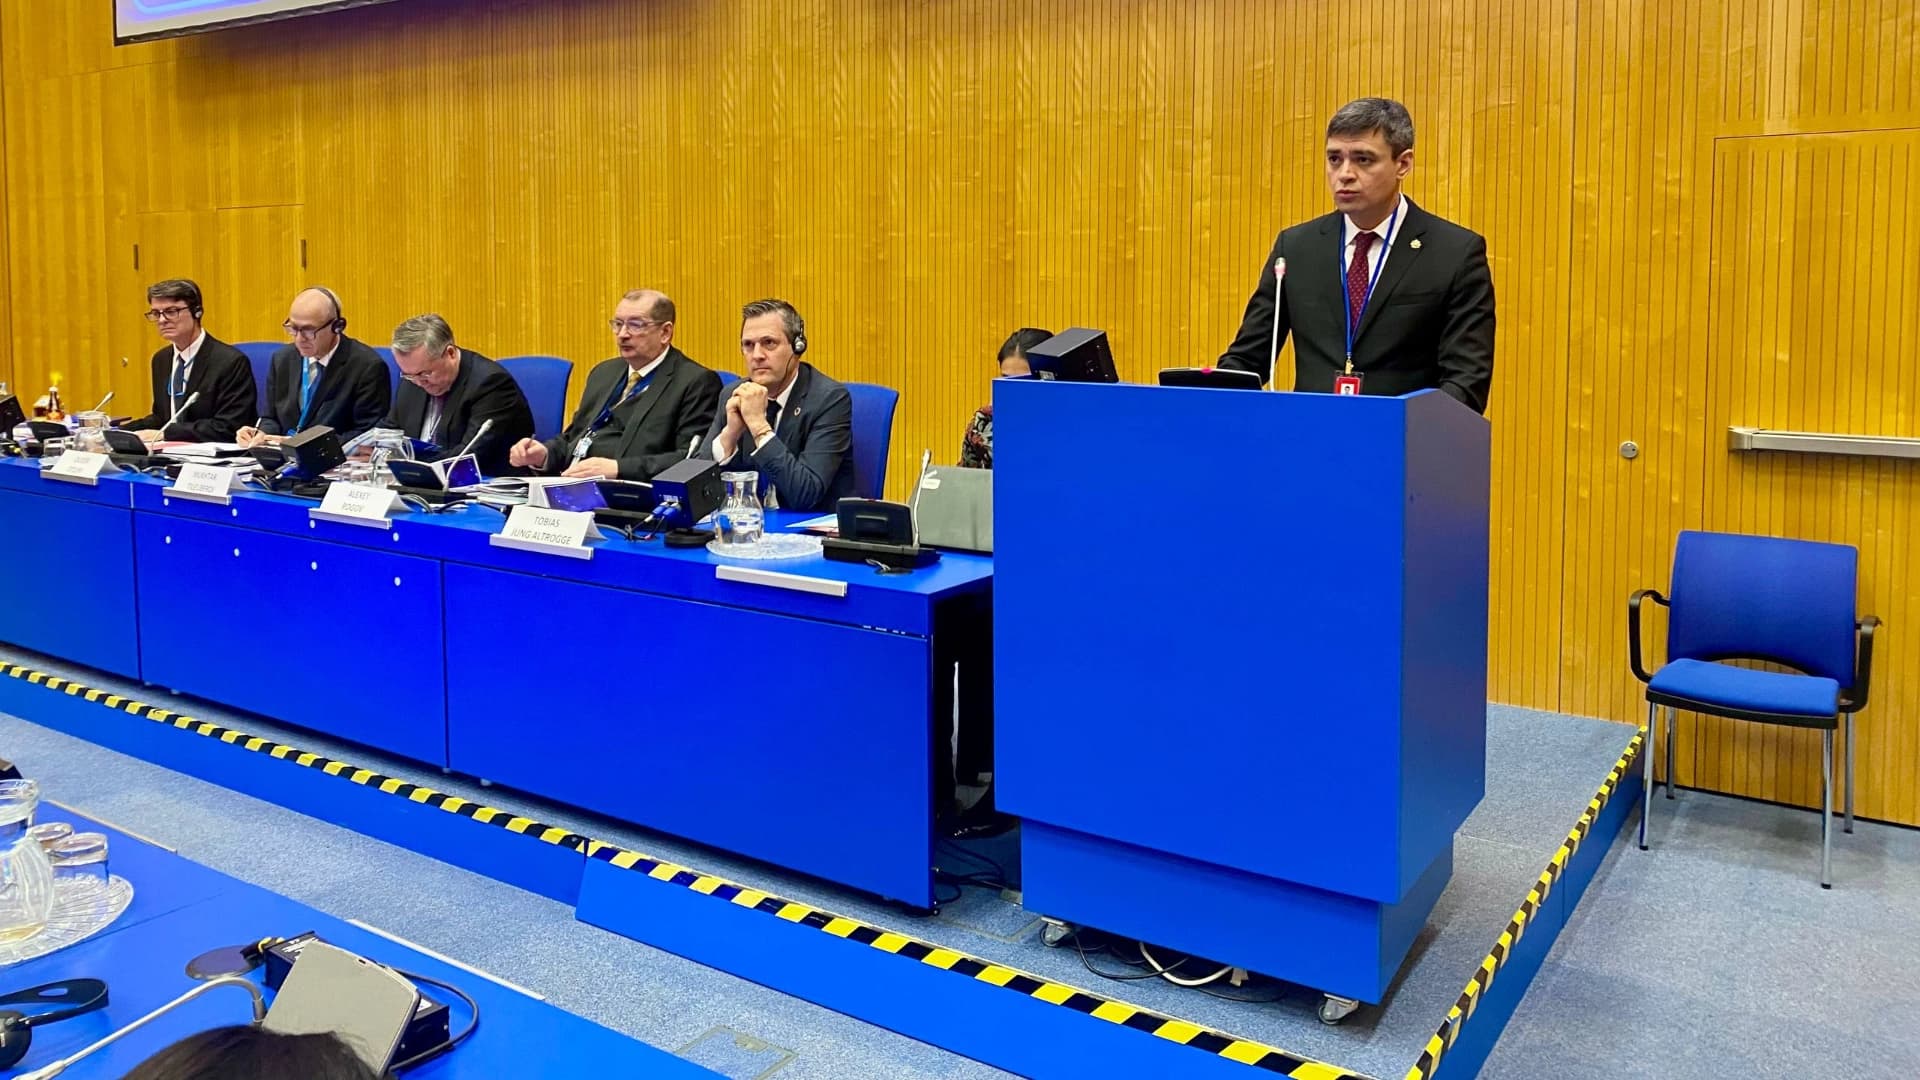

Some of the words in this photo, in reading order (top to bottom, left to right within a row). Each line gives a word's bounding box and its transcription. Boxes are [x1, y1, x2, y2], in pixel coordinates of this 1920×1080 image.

[534, 516, 560, 527] TOBIAS
[511, 528, 531, 539] JUNG
[532, 532, 573, 545] ALTROGGE
